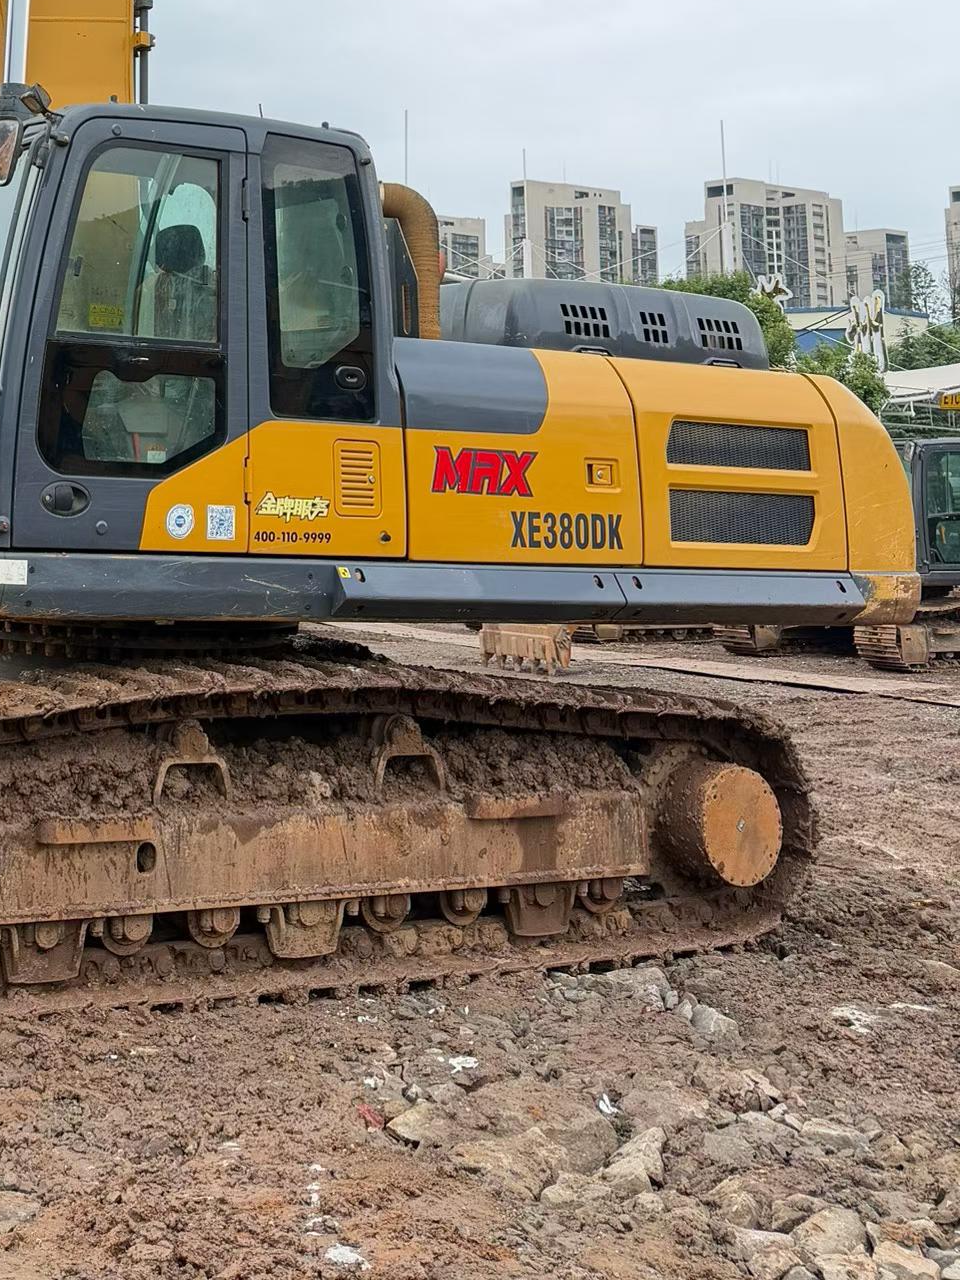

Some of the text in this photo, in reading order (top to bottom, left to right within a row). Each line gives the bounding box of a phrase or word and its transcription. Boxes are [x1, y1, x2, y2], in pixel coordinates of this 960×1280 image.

[431, 445, 538, 497] MAX
[256, 491, 331, 522] 金牌服务
[254, 531, 332, 544] 400-110-9999
[511, 511, 623, 550] XE380DK
